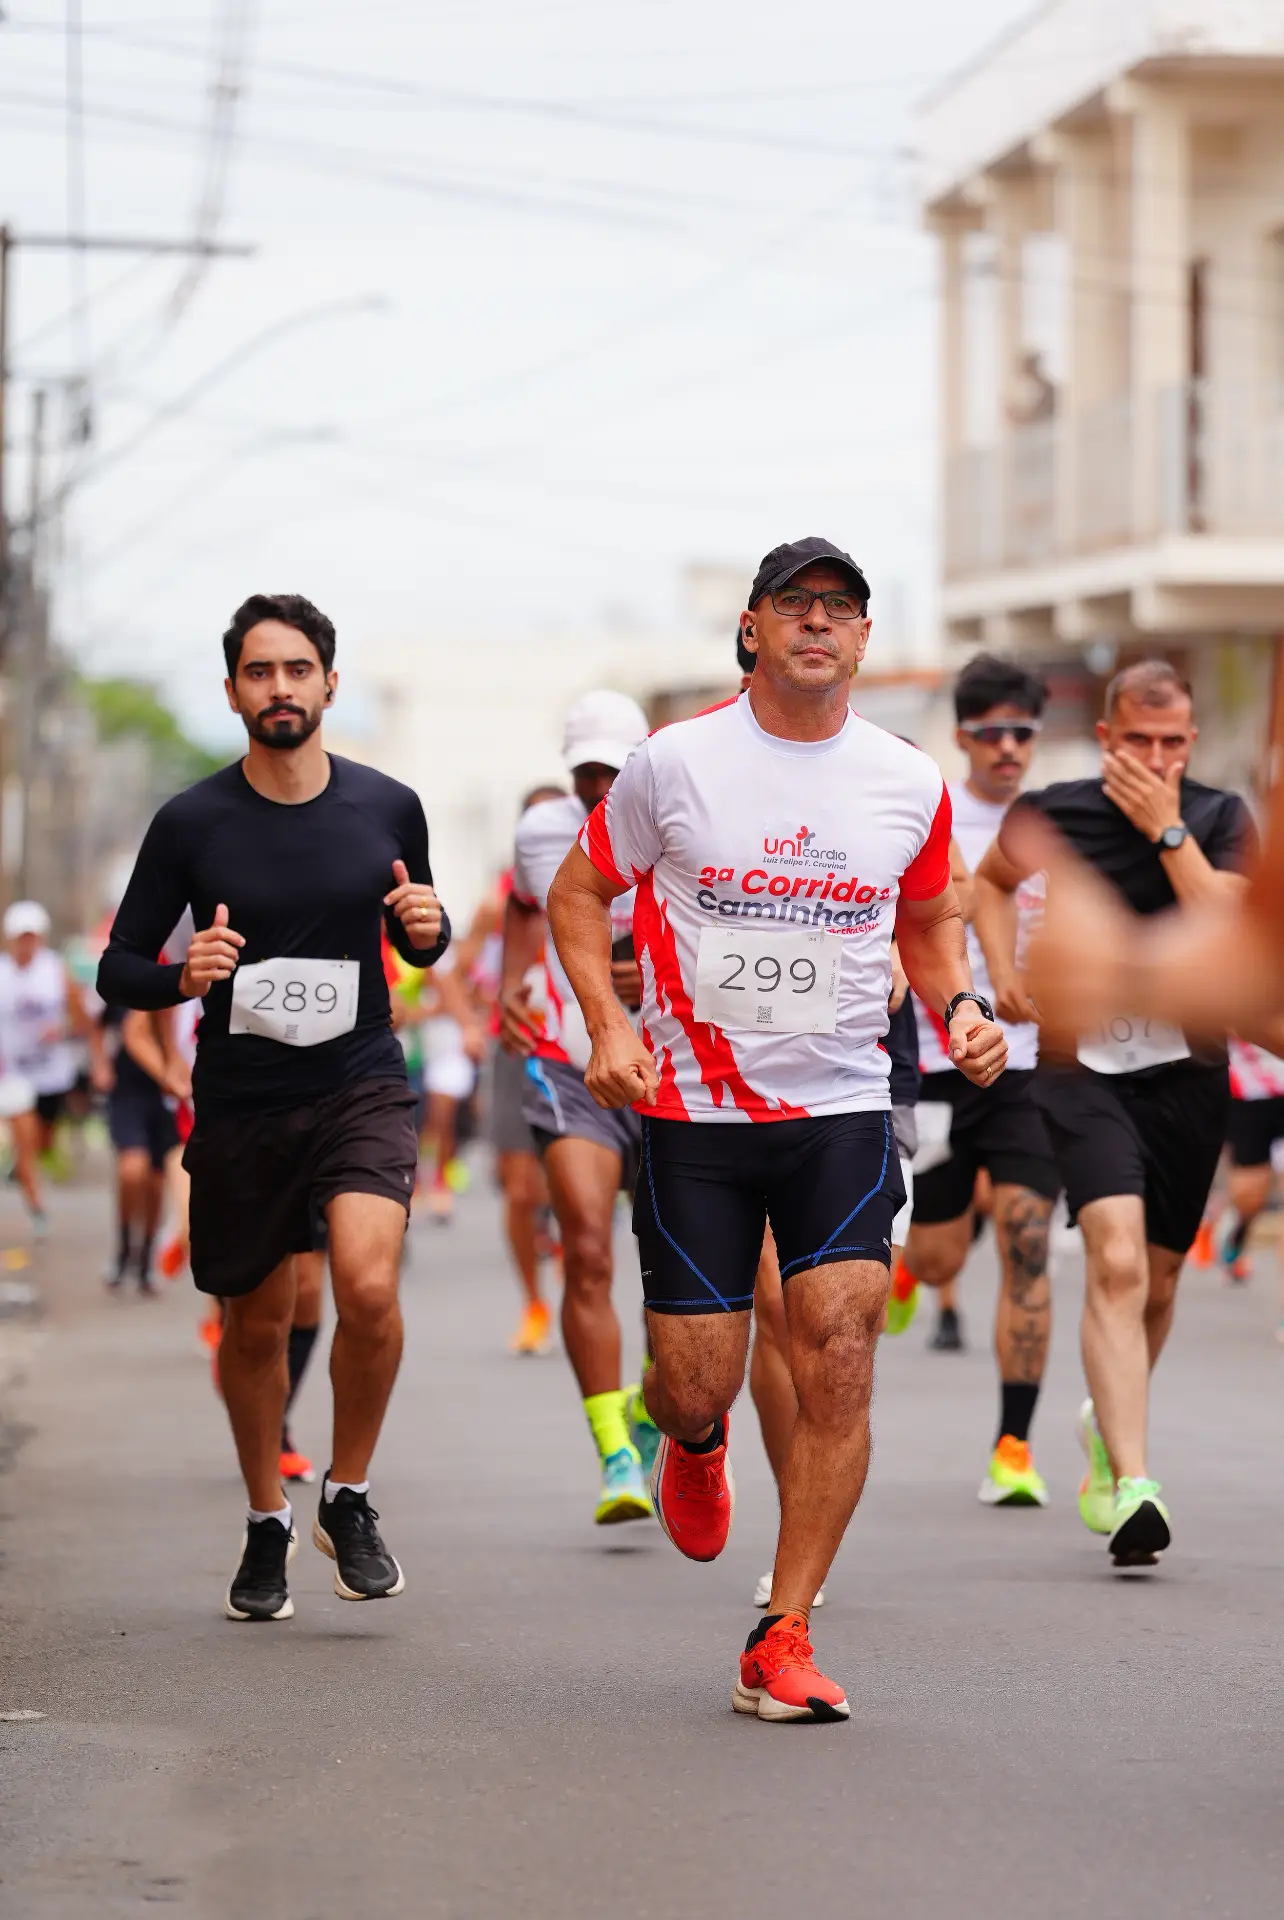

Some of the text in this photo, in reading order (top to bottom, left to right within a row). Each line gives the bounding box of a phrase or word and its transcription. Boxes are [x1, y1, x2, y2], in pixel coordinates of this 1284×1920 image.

[762, 856, 779, 864] Luiz
[780, 858, 804, 867] Felipe
[812, 860, 847, 870] Cruvinel
[741, 869, 878, 904] Corrida
[718, 953, 817, 994] 299
[252, 979, 337, 1013] 289
